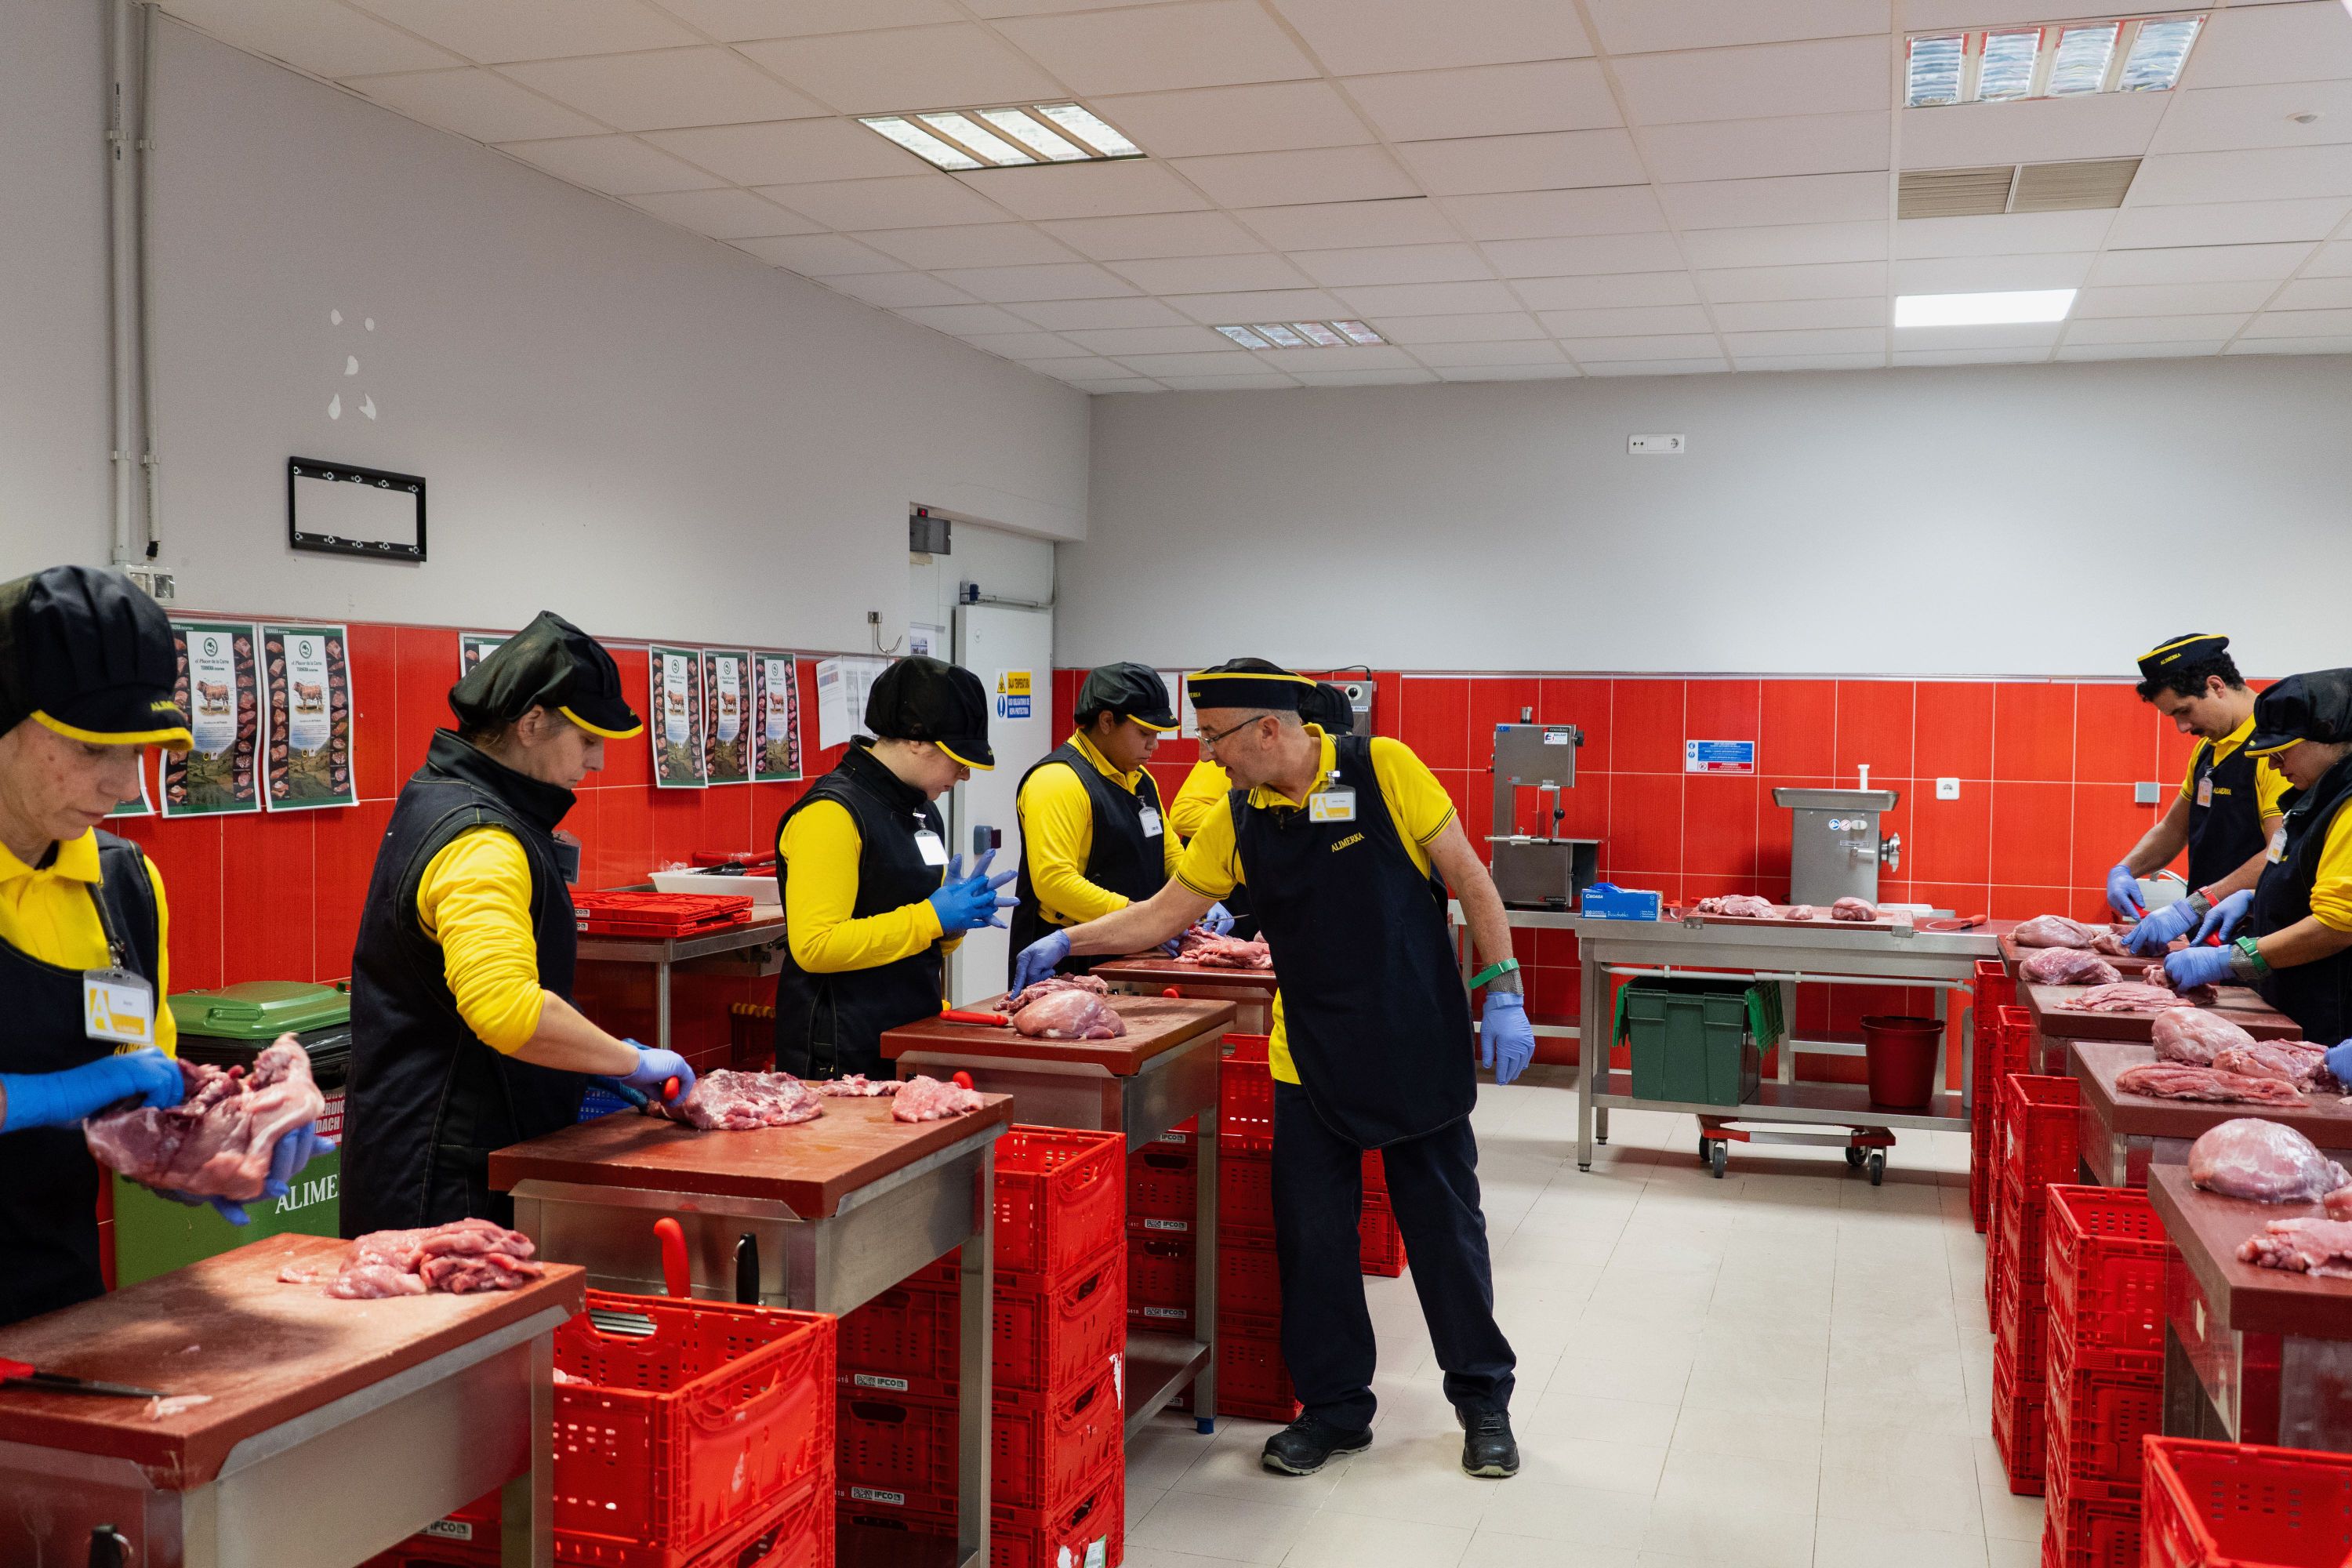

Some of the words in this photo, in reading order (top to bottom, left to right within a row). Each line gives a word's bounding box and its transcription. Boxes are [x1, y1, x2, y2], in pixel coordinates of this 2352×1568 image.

[1331, 832, 1365, 853] ALIMERKA
[325, 1100, 345, 1116] RDIC
[315, 1116, 340, 1134] DACH
[275, 1174, 339, 1214] ALIME
[878, 1377, 897, 1387] IFCO
[874, 1490, 893, 1500] IFCO
[430, 1520, 456, 1533] IFCO
